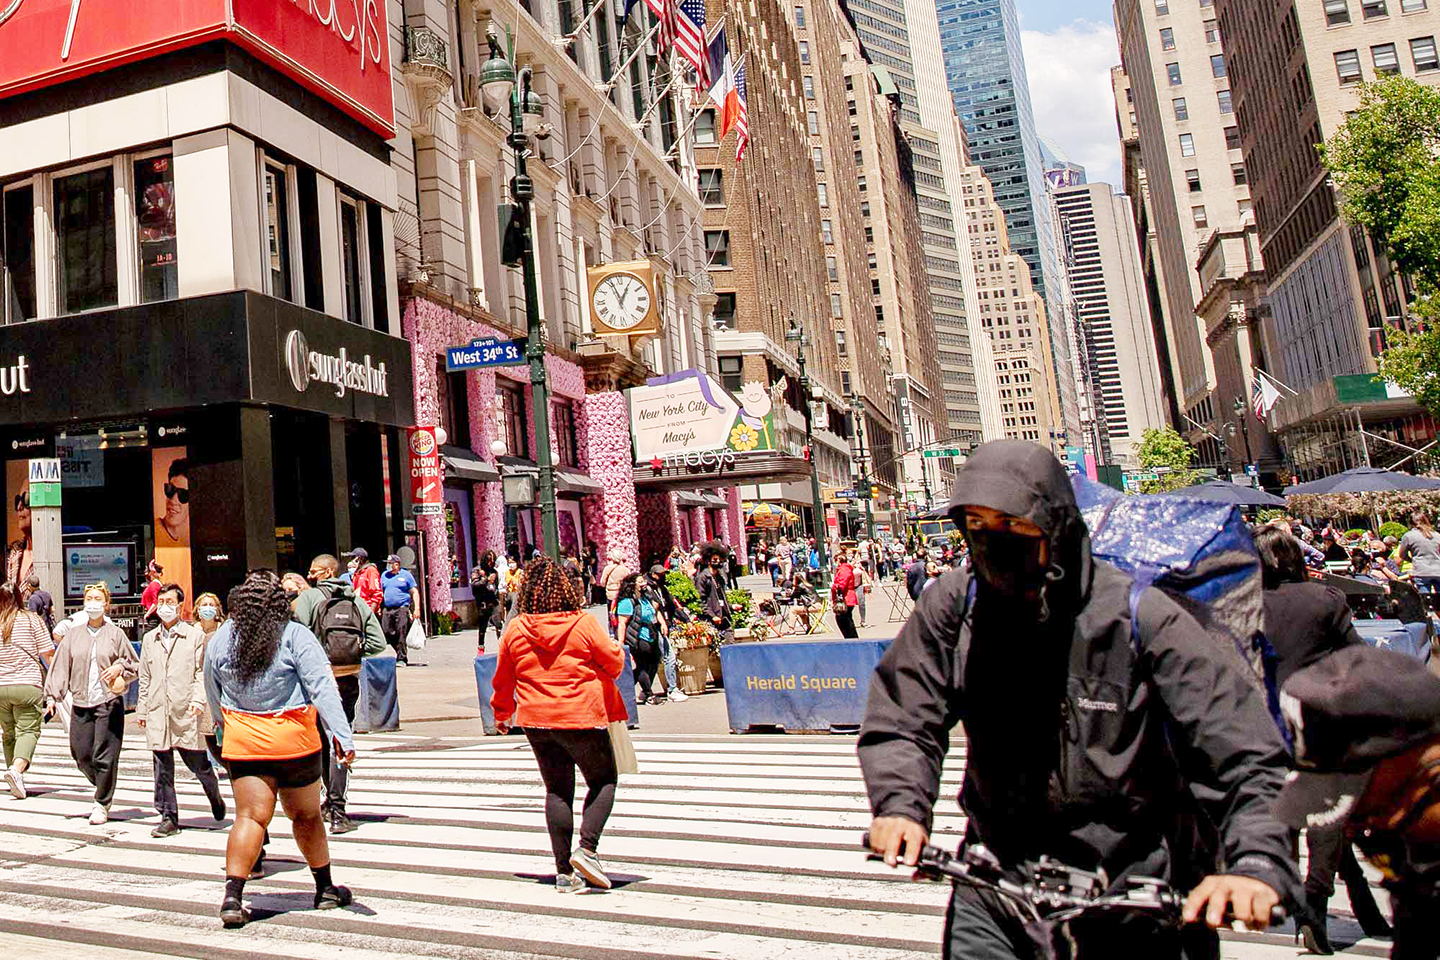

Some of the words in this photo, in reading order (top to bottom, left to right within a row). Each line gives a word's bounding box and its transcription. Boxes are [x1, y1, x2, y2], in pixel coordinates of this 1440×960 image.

[452, 351, 481, 365] West
[483, 346, 503, 362] 34th
[506, 346, 519, 359] St
[309, 347, 368, 398] sunglass
[364, 354, 389, 398] hut
[639, 409, 659, 421] New
[662, 402, 685, 417] York
[687, 400, 709, 416] City
[662, 427, 696, 446] Macy's
[413, 457, 435, 467] NOW
[411, 467, 438, 477] OPEN
[746, 674, 796, 690] Herald
[800, 674, 857, 693] Square
[1077, 697, 1118, 712] Marmot
